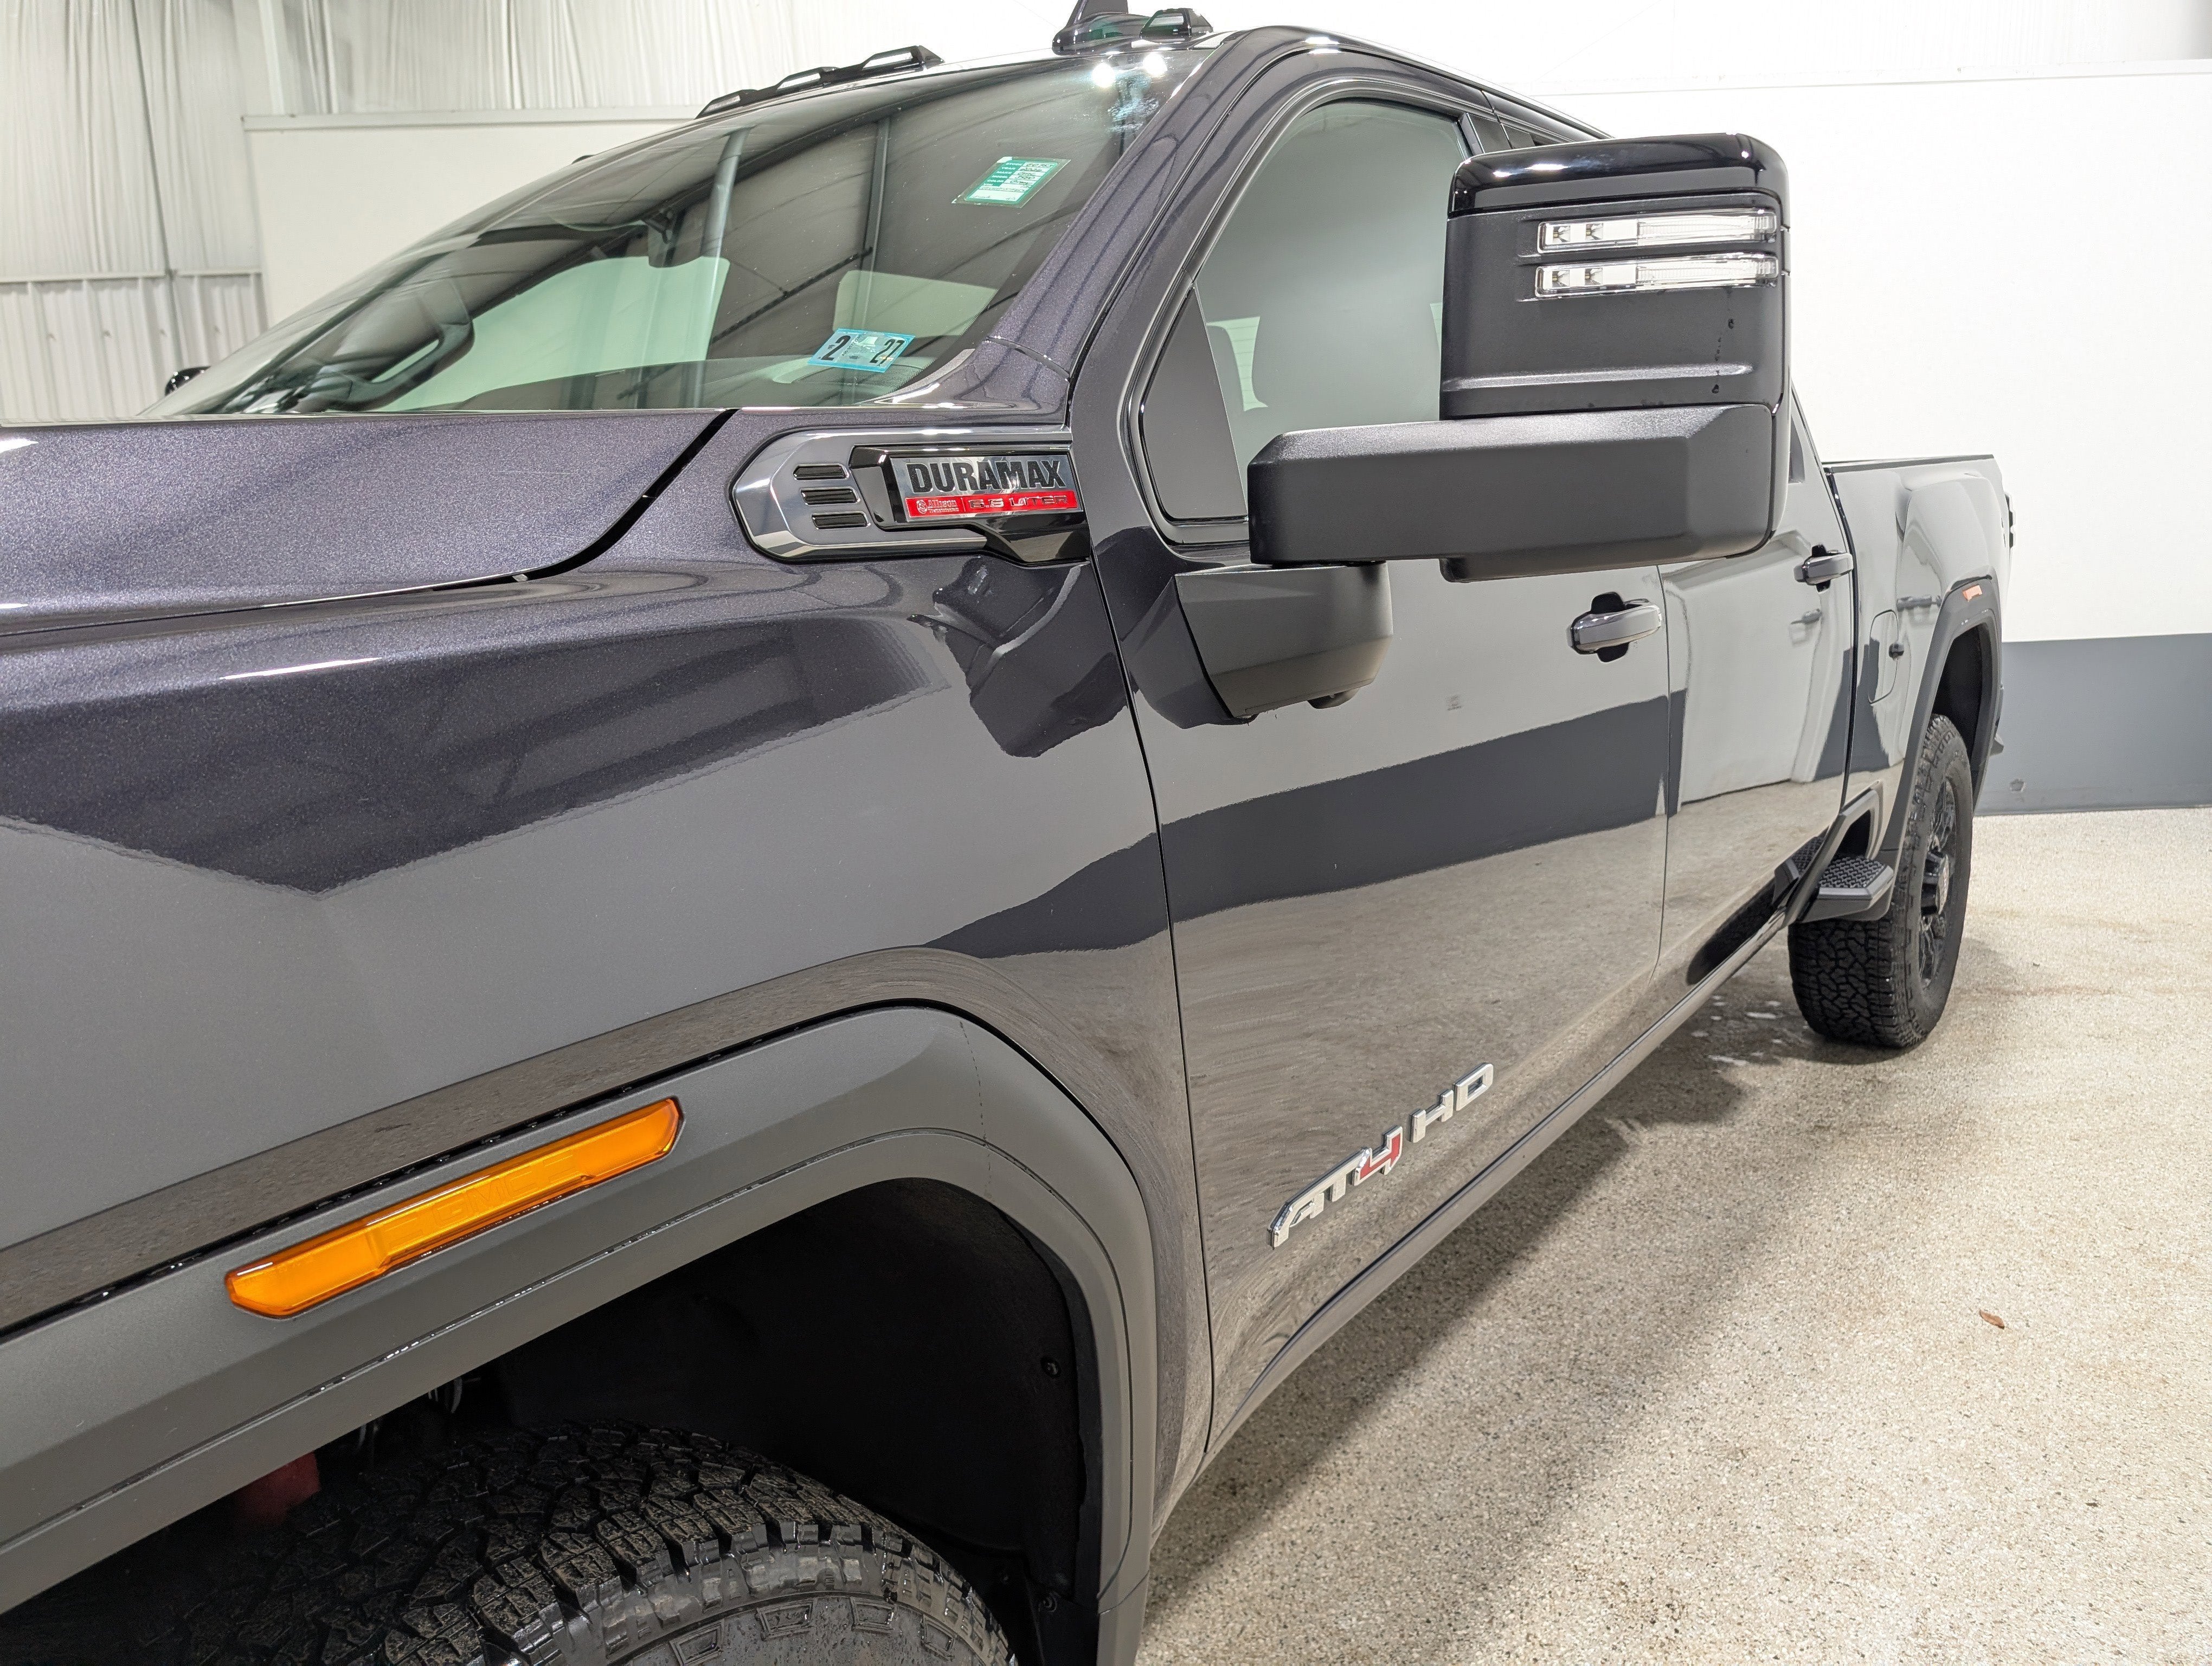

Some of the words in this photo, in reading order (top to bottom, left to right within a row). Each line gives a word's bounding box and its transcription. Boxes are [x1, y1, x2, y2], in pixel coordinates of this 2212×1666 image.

[821, 335, 851, 361] 2
[869, 338, 905, 364] 27
[905, 460, 1066, 494] DURAMAX
[1009, 495, 1068, 507] LITER
[1267, 1125, 1403, 1249] AT4
[1411, 1062, 1494, 1143] HD
[432, 1171, 537, 1223] GMC
